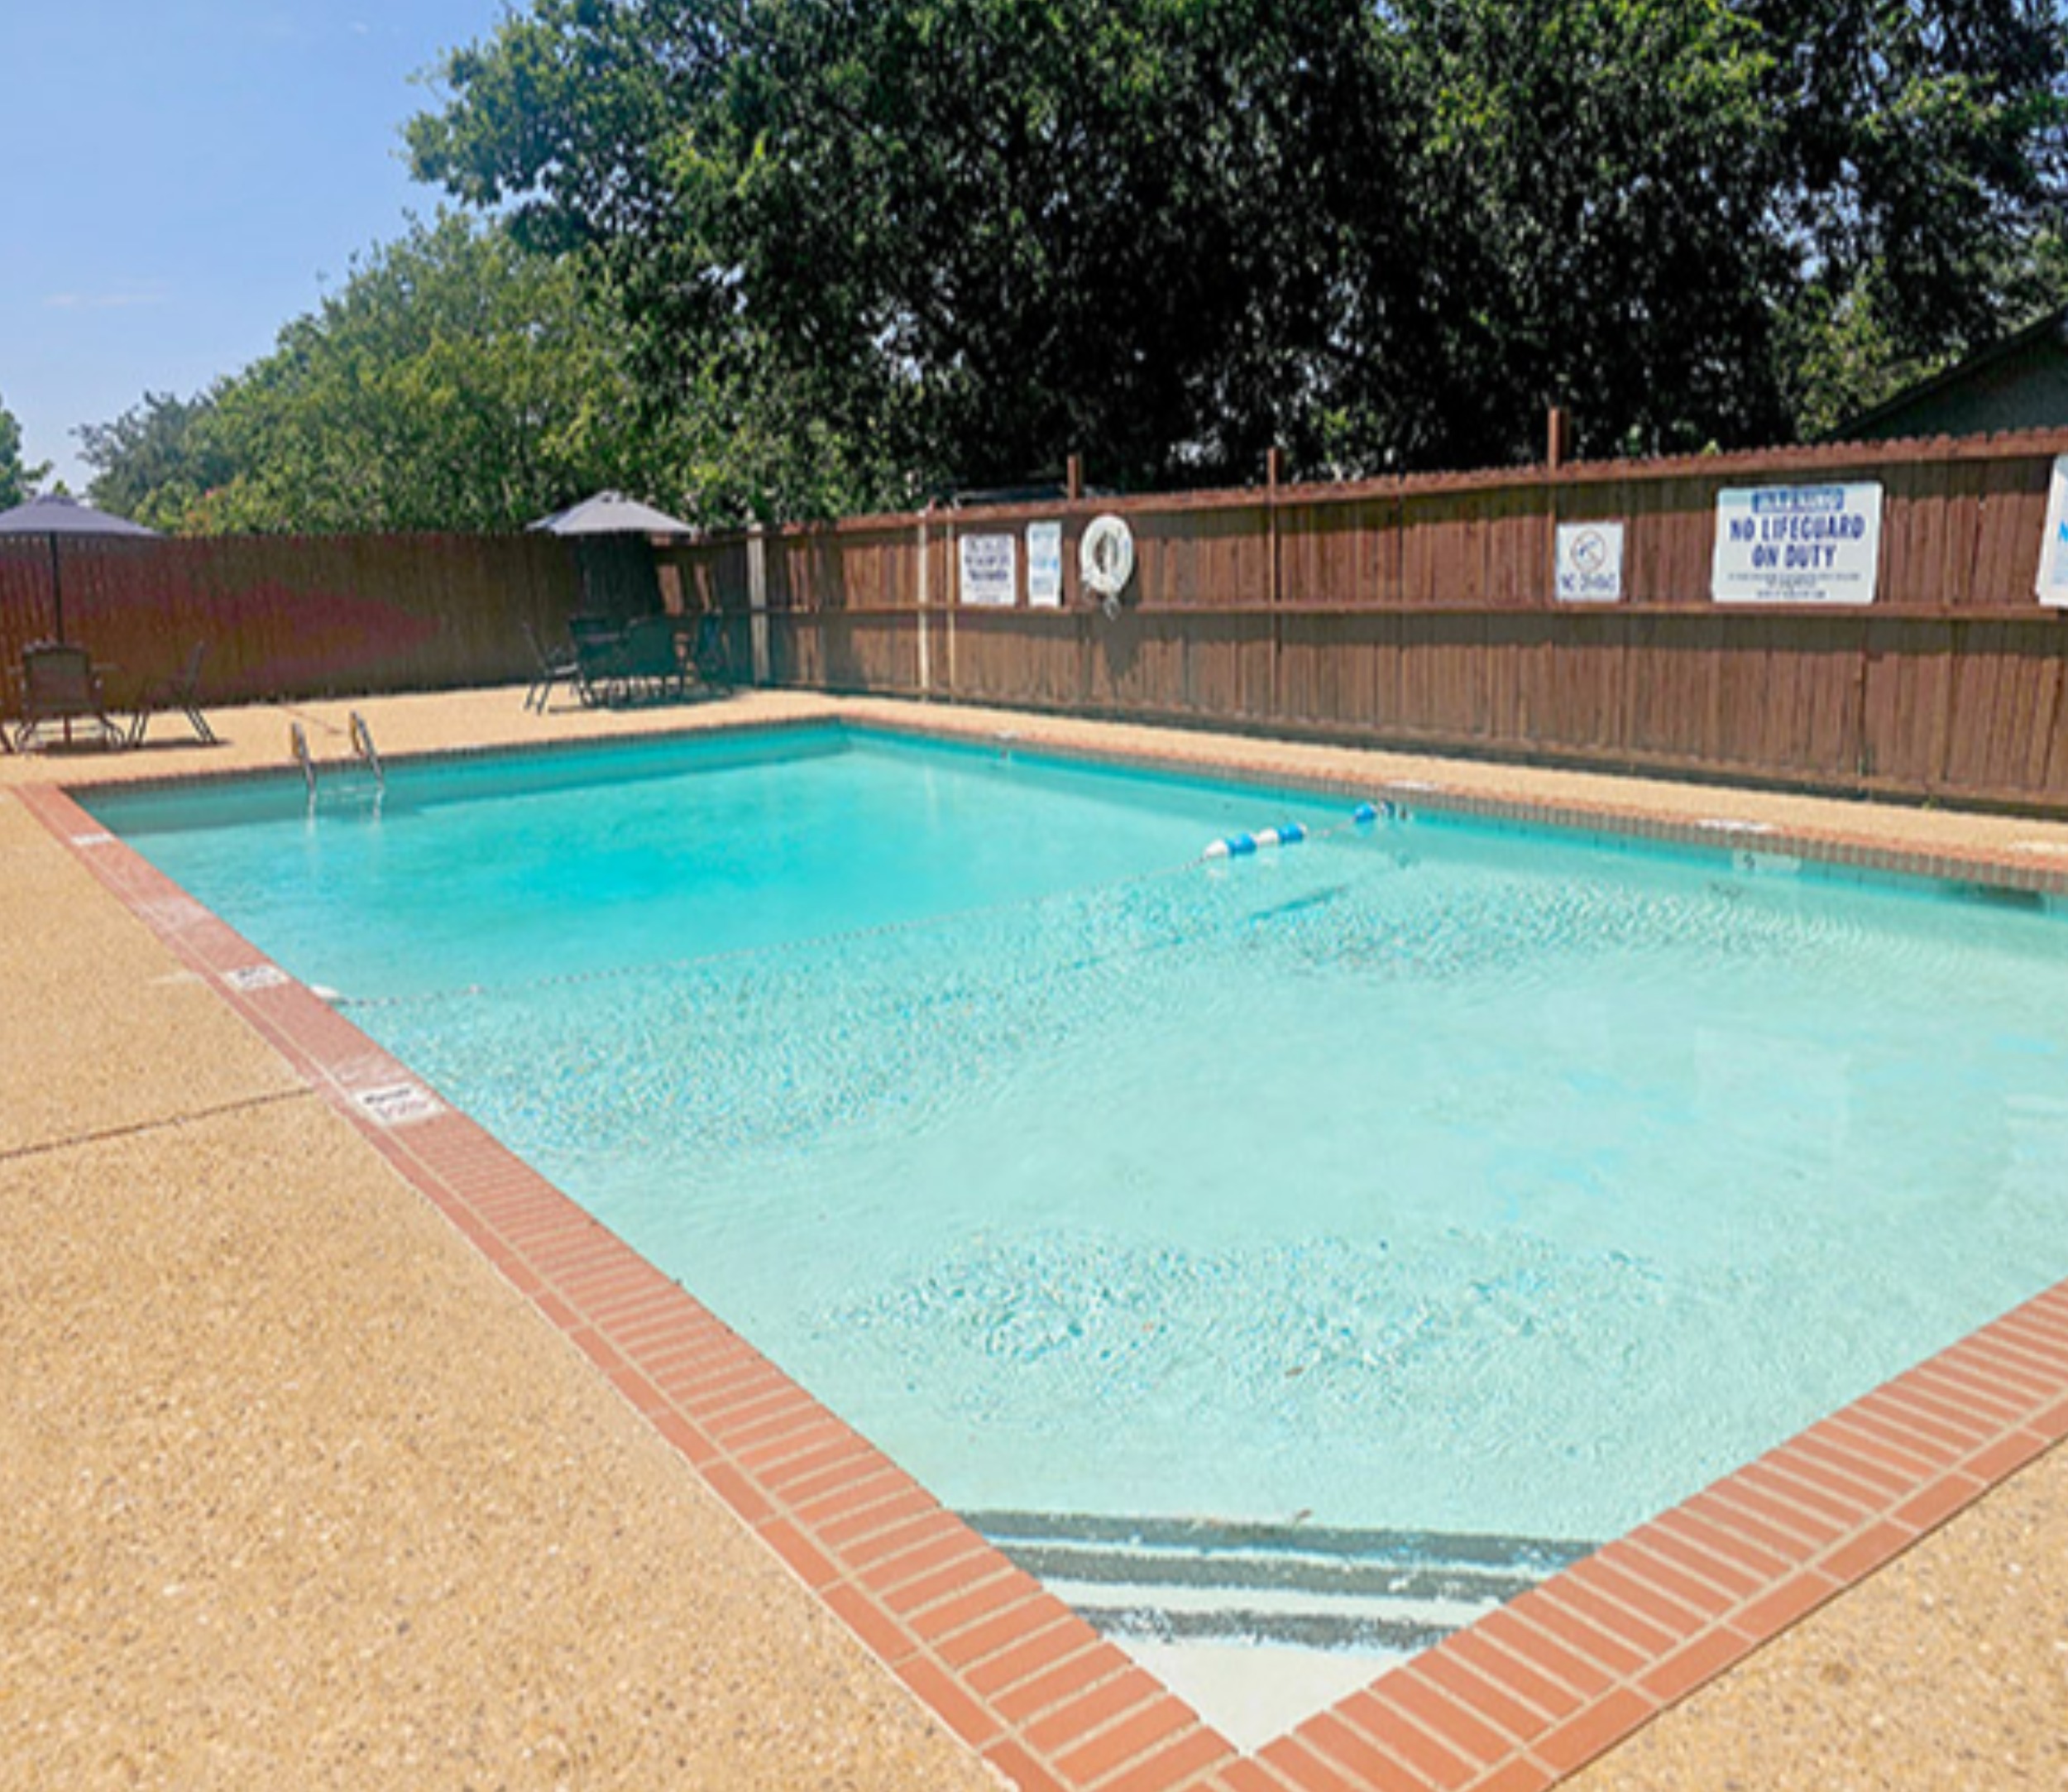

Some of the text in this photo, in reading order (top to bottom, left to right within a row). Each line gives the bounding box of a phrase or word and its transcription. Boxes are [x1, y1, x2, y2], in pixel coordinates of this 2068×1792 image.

[1730, 514, 1865, 541] NO LIFEGUARD
[1751, 544, 1837, 568] ON DUTY
